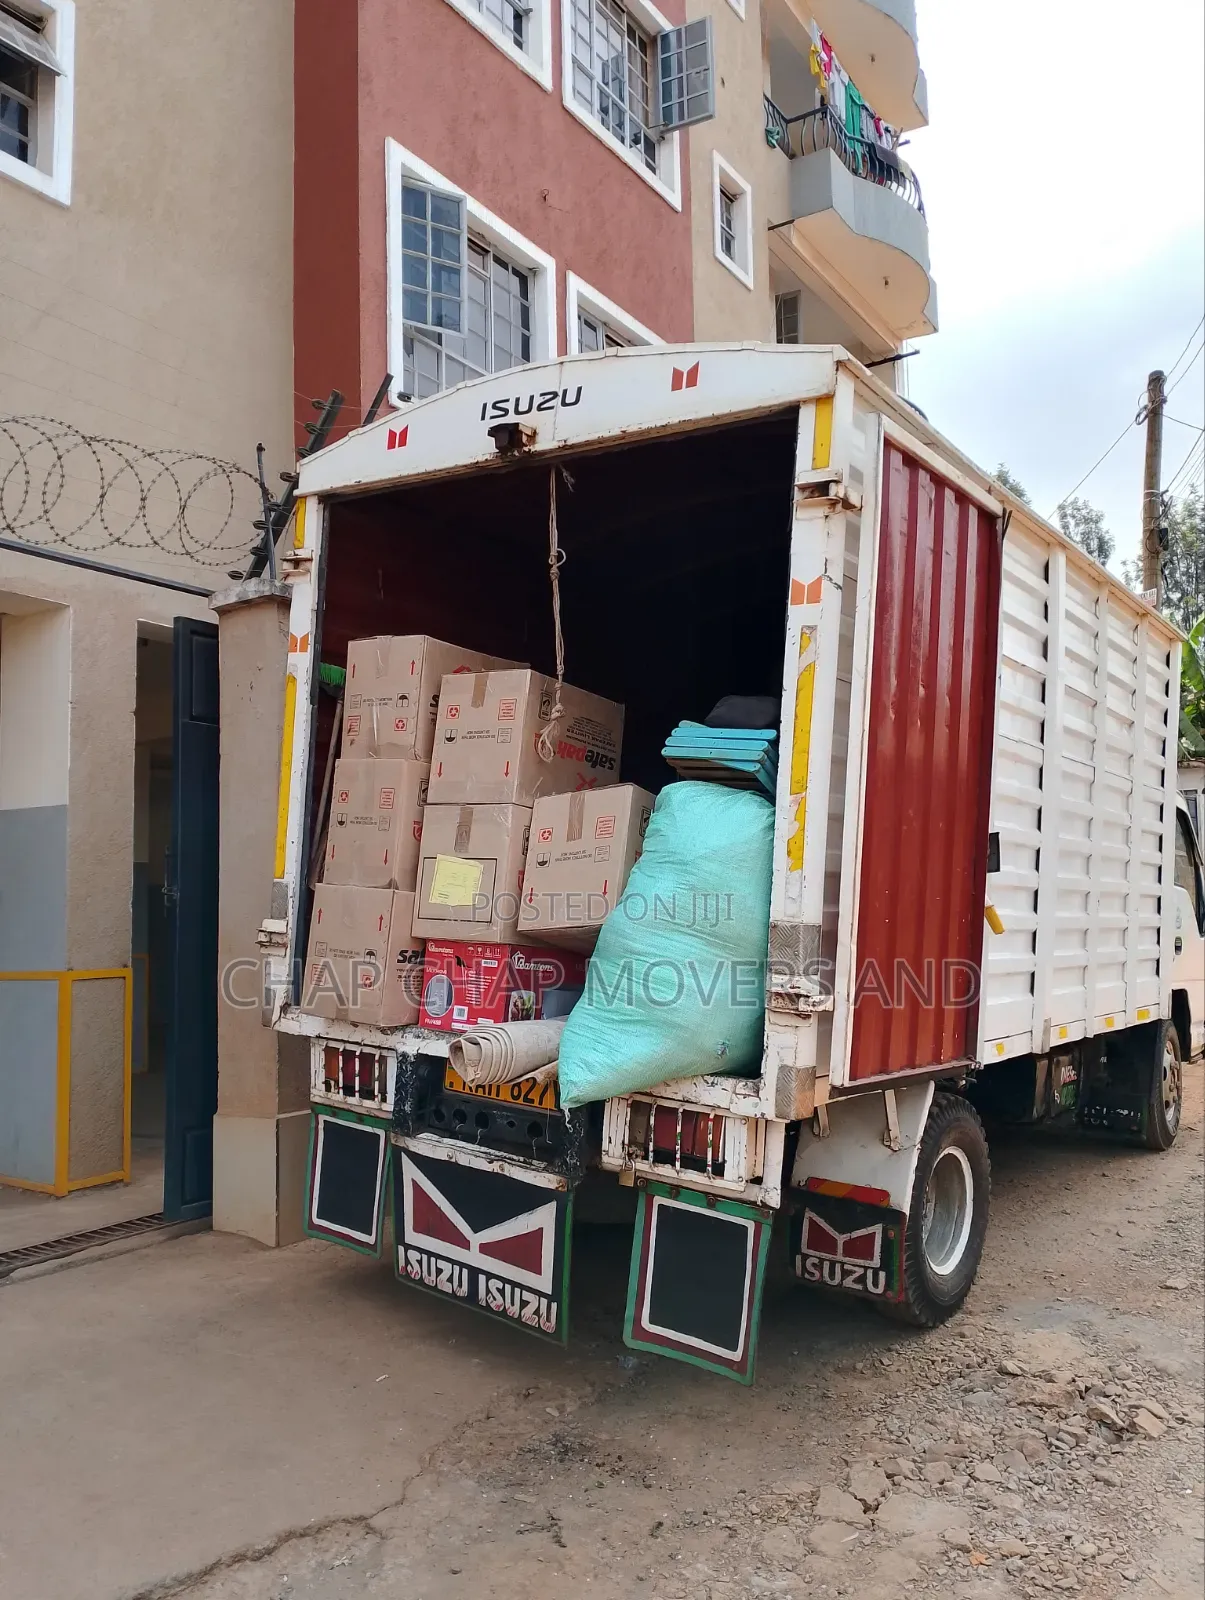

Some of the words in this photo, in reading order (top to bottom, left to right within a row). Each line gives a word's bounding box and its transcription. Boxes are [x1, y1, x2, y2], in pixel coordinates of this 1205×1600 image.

[480, 385, 583, 422] ISUZU
[557, 740, 616, 771] safepak
[513, 954, 555, 973] Ramtons
[398, 1245, 469, 1297] ISUZU
[478, 1273, 558, 1334] ISUZU
[795, 1254, 887, 1294] ISUZU
